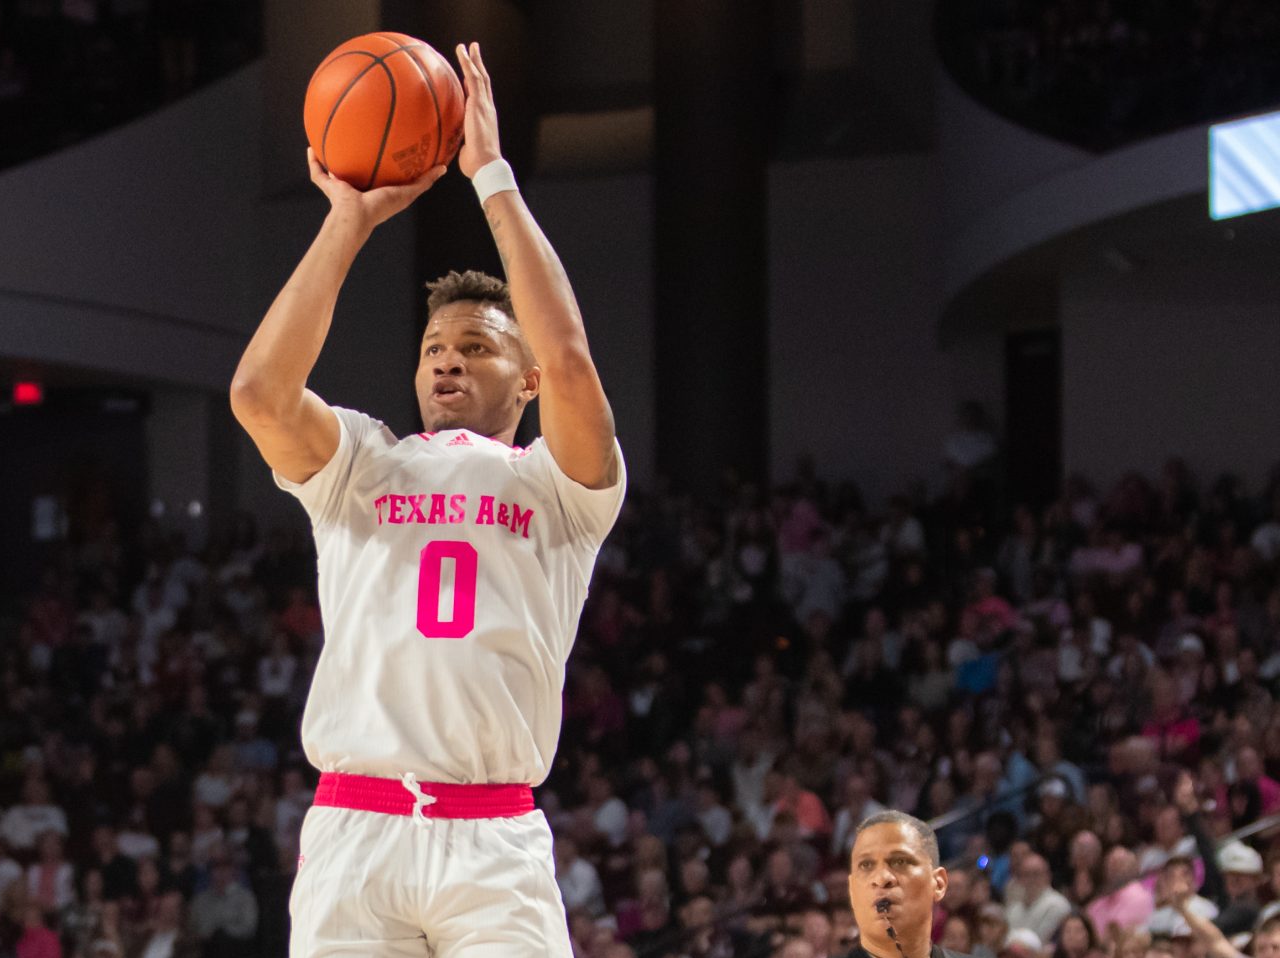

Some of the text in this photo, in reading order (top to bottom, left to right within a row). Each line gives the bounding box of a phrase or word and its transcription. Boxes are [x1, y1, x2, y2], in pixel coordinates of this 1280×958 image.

[375, 493, 534, 539] TEXAS A&M
[416, 540, 478, 638] 0
